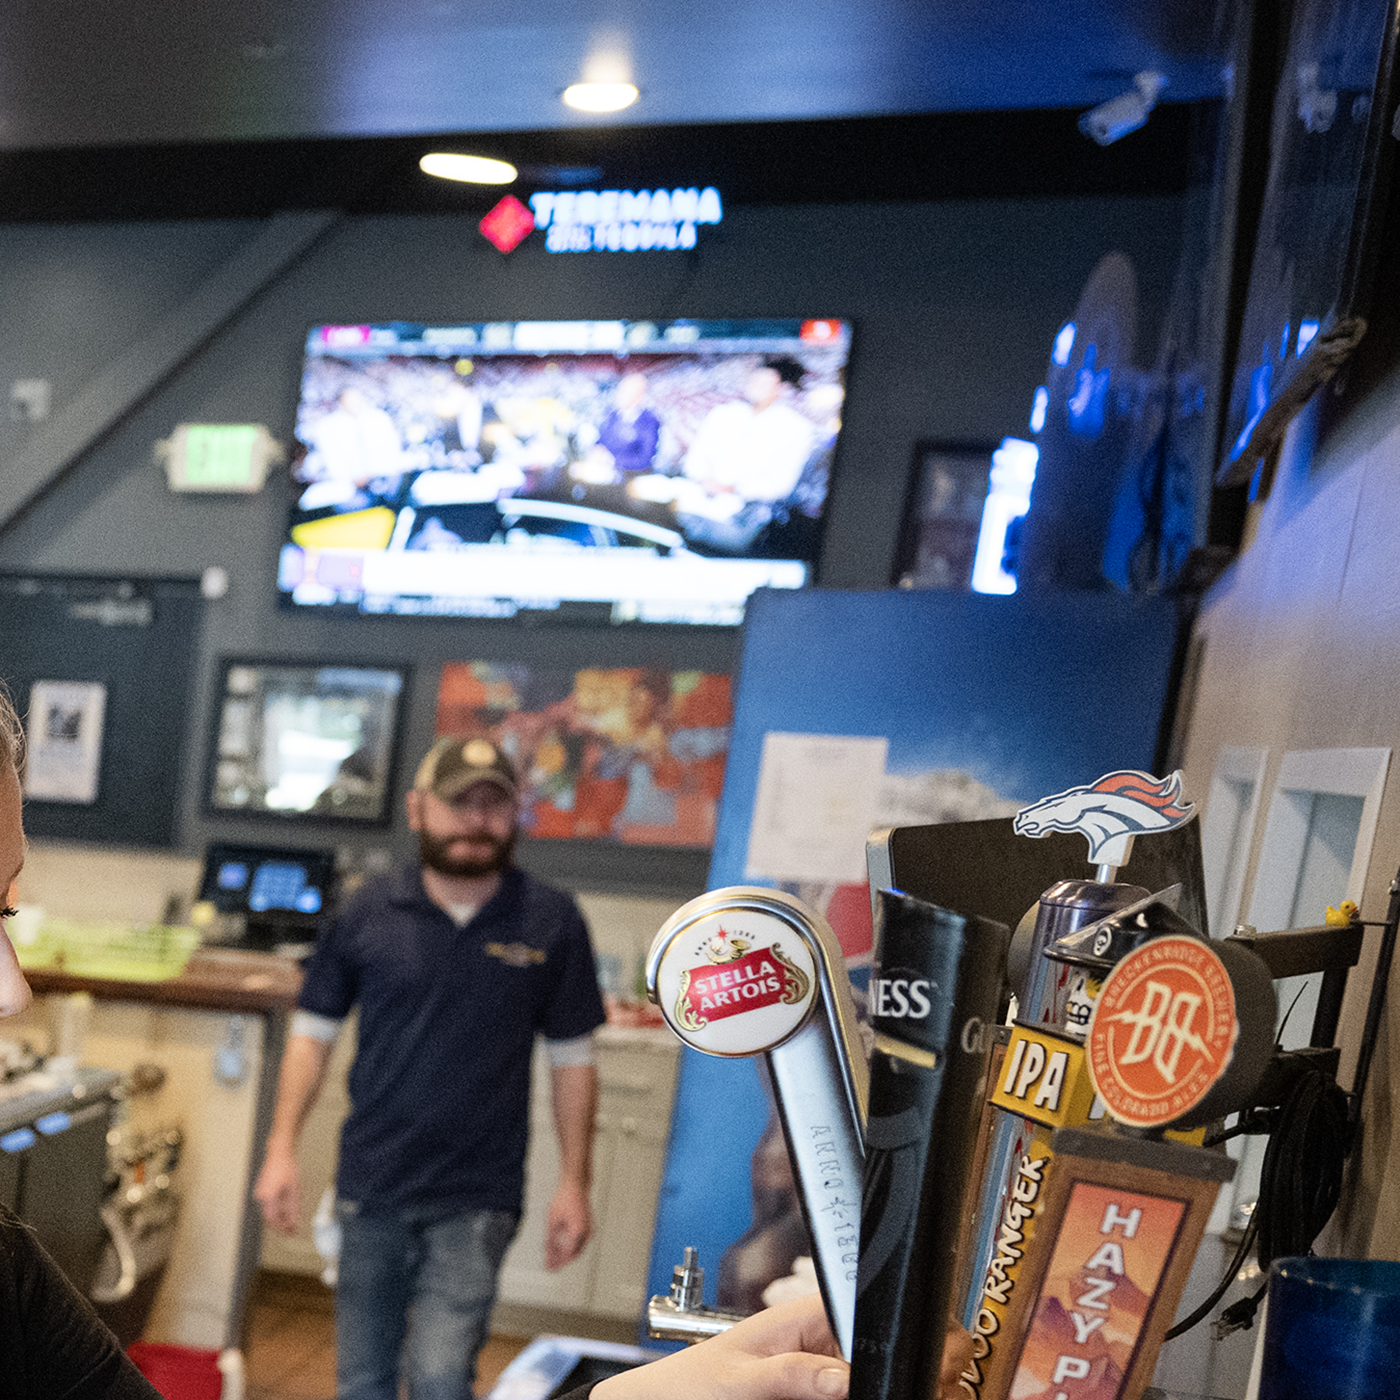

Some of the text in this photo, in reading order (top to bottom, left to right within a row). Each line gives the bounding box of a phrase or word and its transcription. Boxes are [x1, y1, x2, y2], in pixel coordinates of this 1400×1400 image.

[694, 961, 776, 994] STELLA
[700, 976, 780, 1011] ARTOIS
[1004, 1040, 1070, 1112] IPA
[984, 1155, 1051, 1305] RANGER
[1070, 1203, 1143, 1345] HAZY
